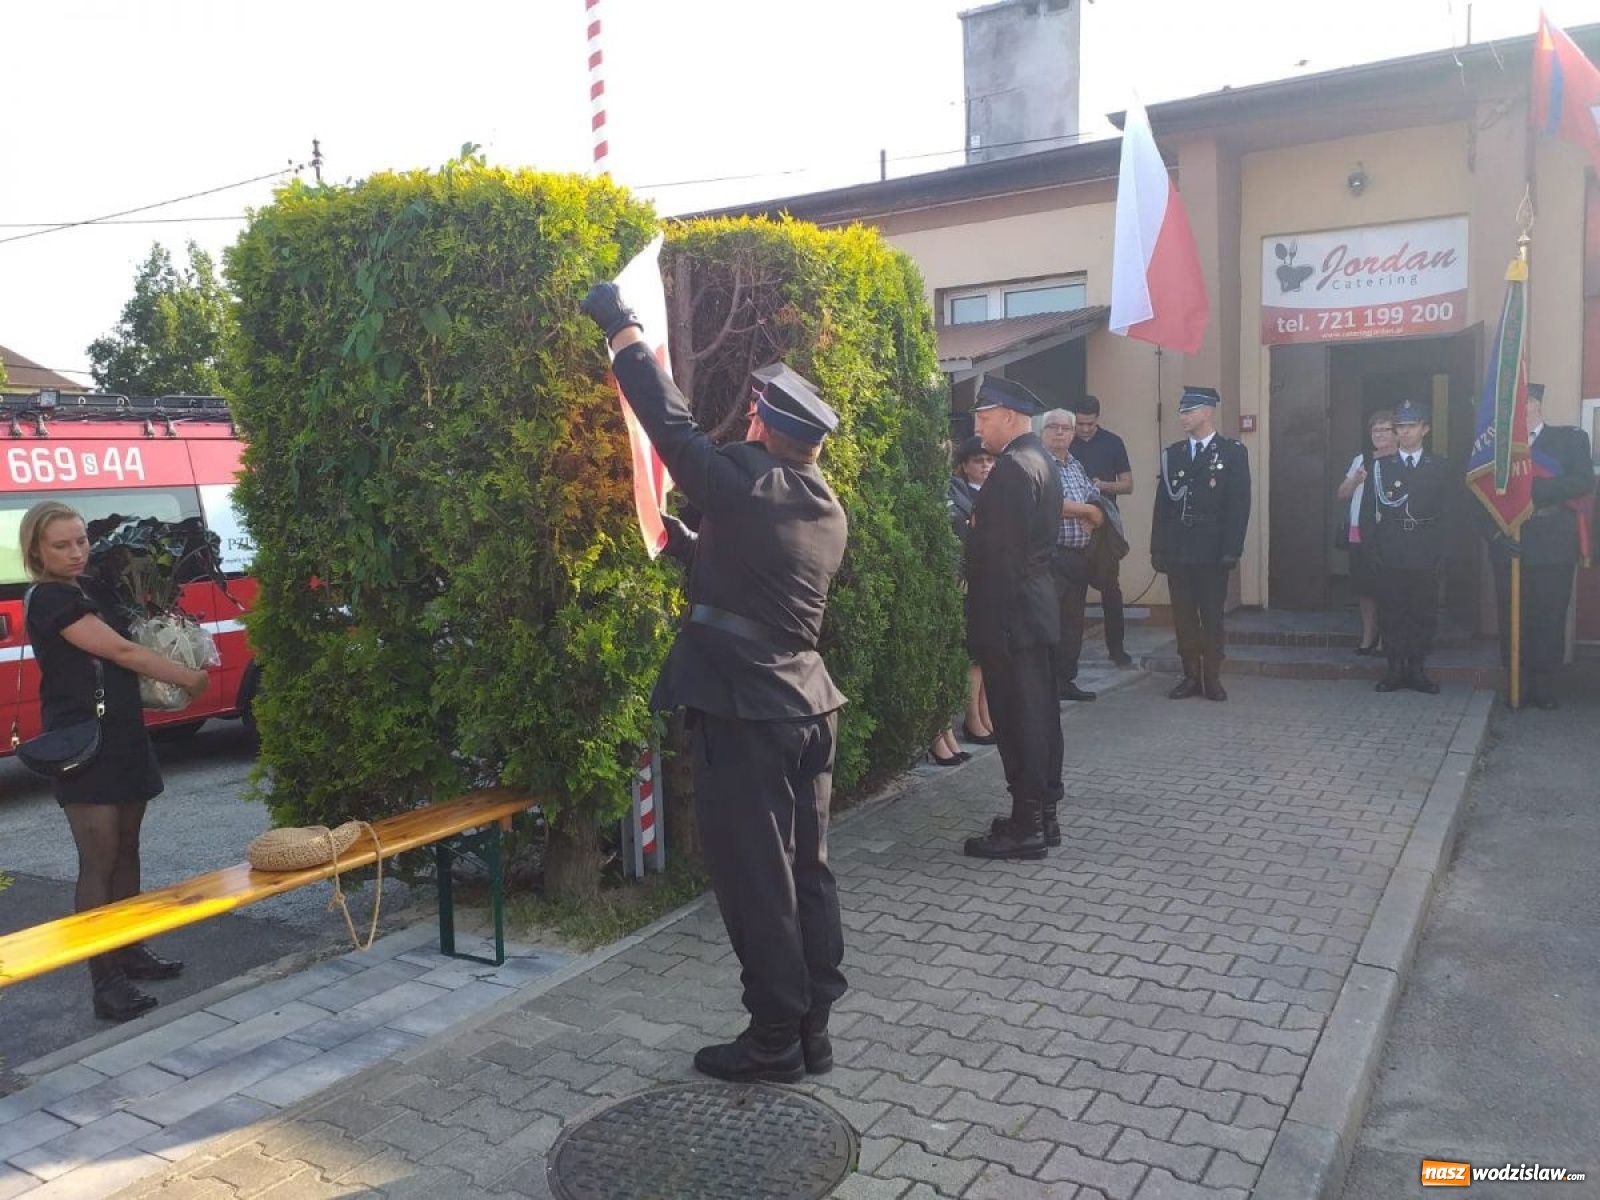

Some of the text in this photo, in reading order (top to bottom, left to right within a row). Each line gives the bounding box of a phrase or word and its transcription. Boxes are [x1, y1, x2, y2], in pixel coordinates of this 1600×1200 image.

[1316, 241, 1457, 291] Jordan
[1332, 274, 1419, 290] Catering
[1277, 302, 1454, 333] tel. 721 199 200
[8, 447, 78, 483] 669
[103, 446, 145, 481] 44
